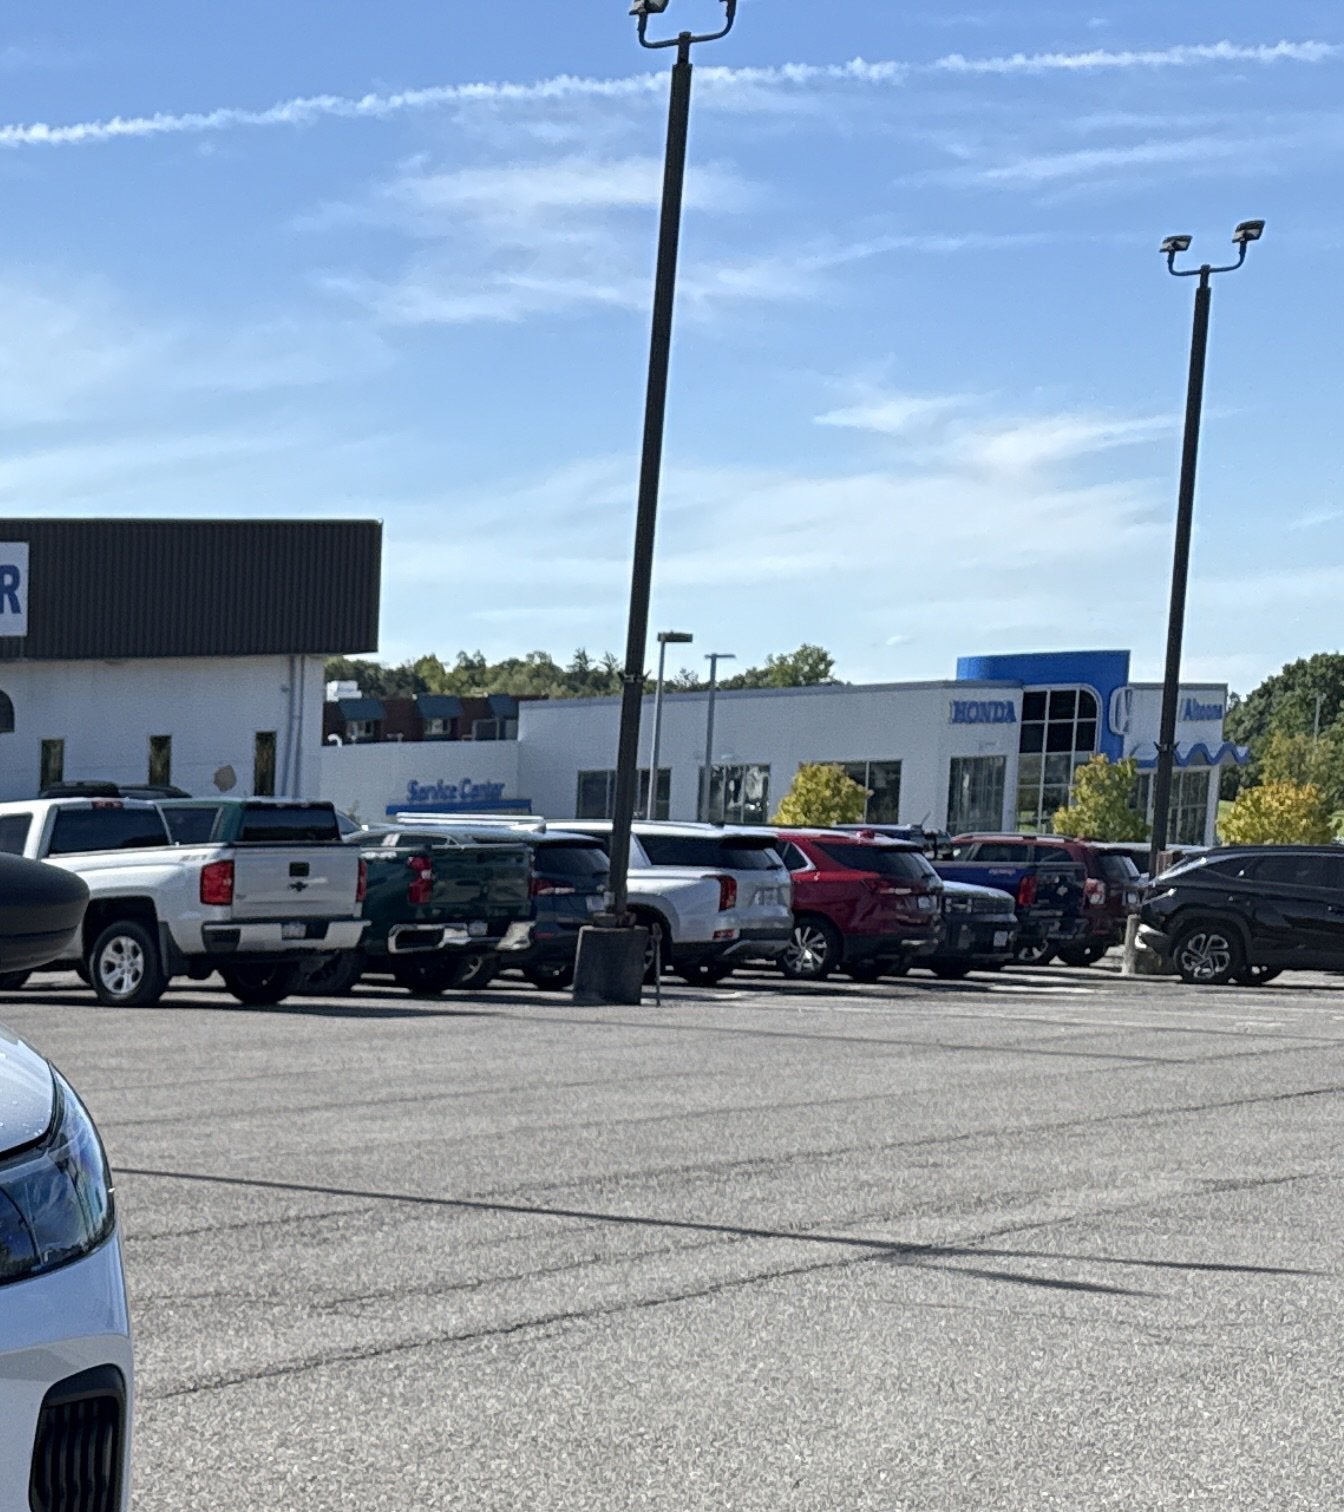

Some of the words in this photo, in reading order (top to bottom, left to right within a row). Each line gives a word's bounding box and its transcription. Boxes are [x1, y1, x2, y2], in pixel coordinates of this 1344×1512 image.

[950, 700, 1017, 723] HONDA
[406, 779, 458, 801] Service
[459, 777, 506, 800] Center
